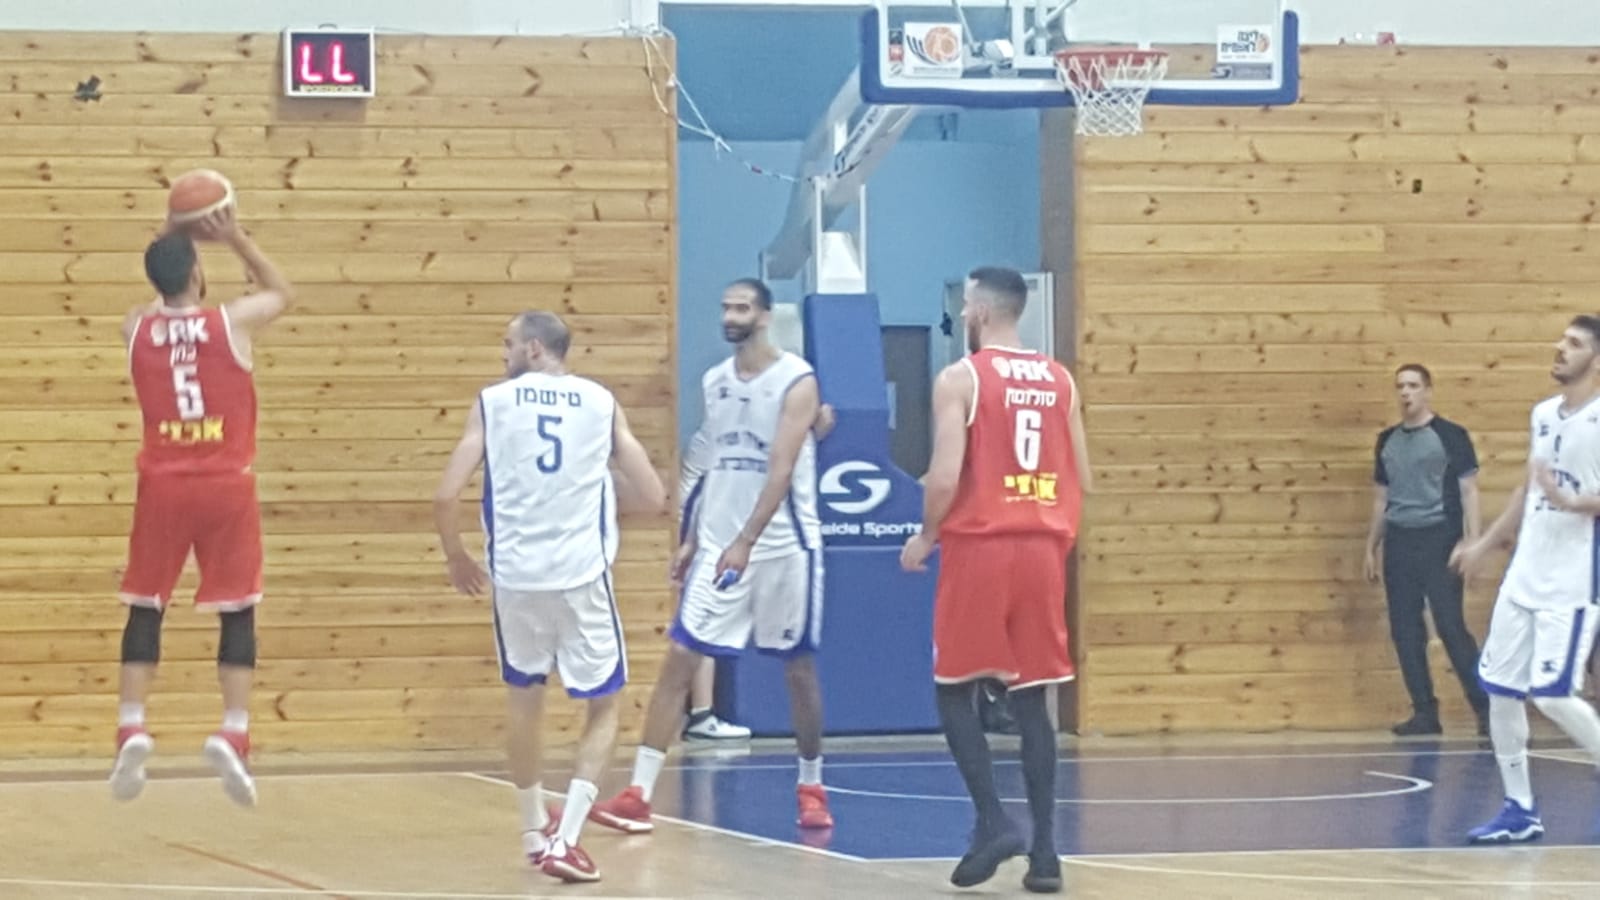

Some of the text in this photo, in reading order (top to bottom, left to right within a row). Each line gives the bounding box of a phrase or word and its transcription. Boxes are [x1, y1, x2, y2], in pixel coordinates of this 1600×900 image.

[173, 365, 205, 419] 5
[536, 413, 563, 474] 5
[1015, 409, 1041, 471] 6
